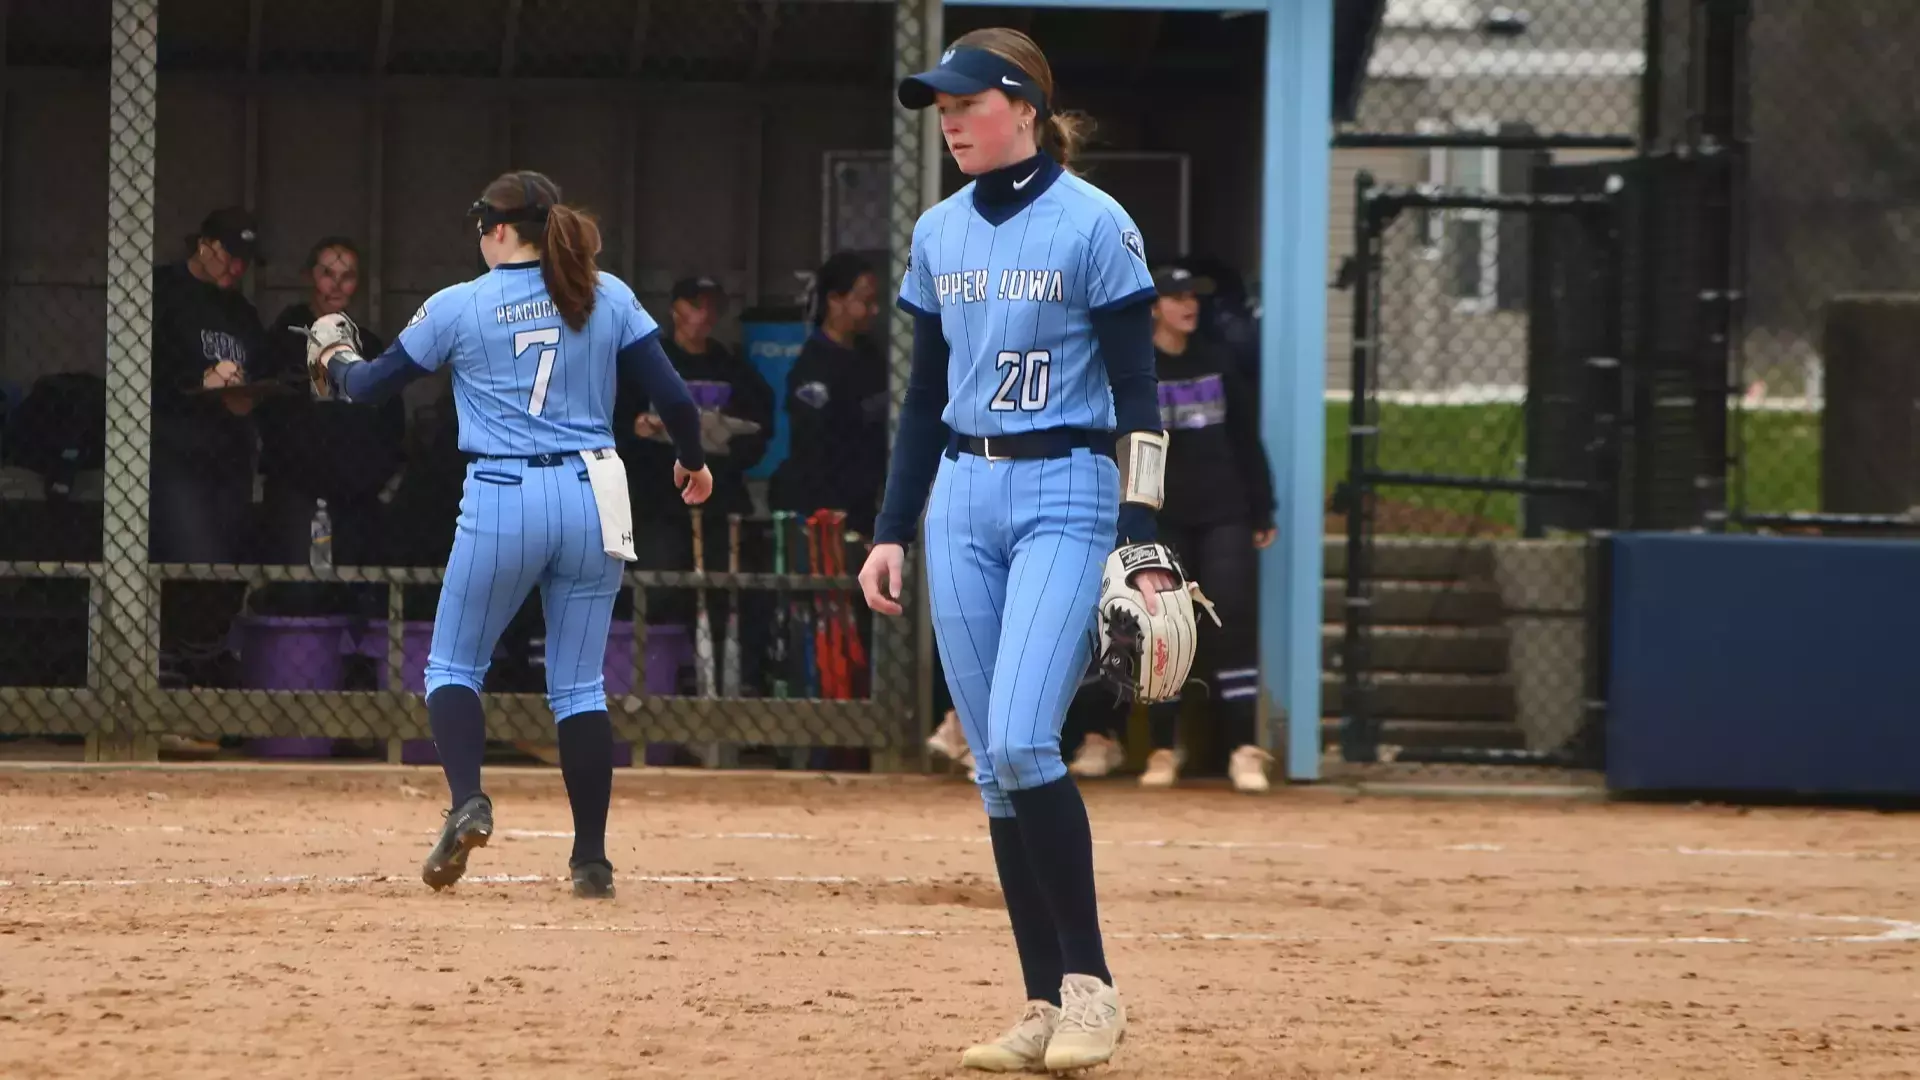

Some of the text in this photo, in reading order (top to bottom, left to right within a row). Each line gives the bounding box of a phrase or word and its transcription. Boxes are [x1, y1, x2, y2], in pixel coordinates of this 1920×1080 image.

[997, 269, 1063, 302] IOWA
[513, 327, 560, 417] 7
[989, 351, 1050, 411] 20
